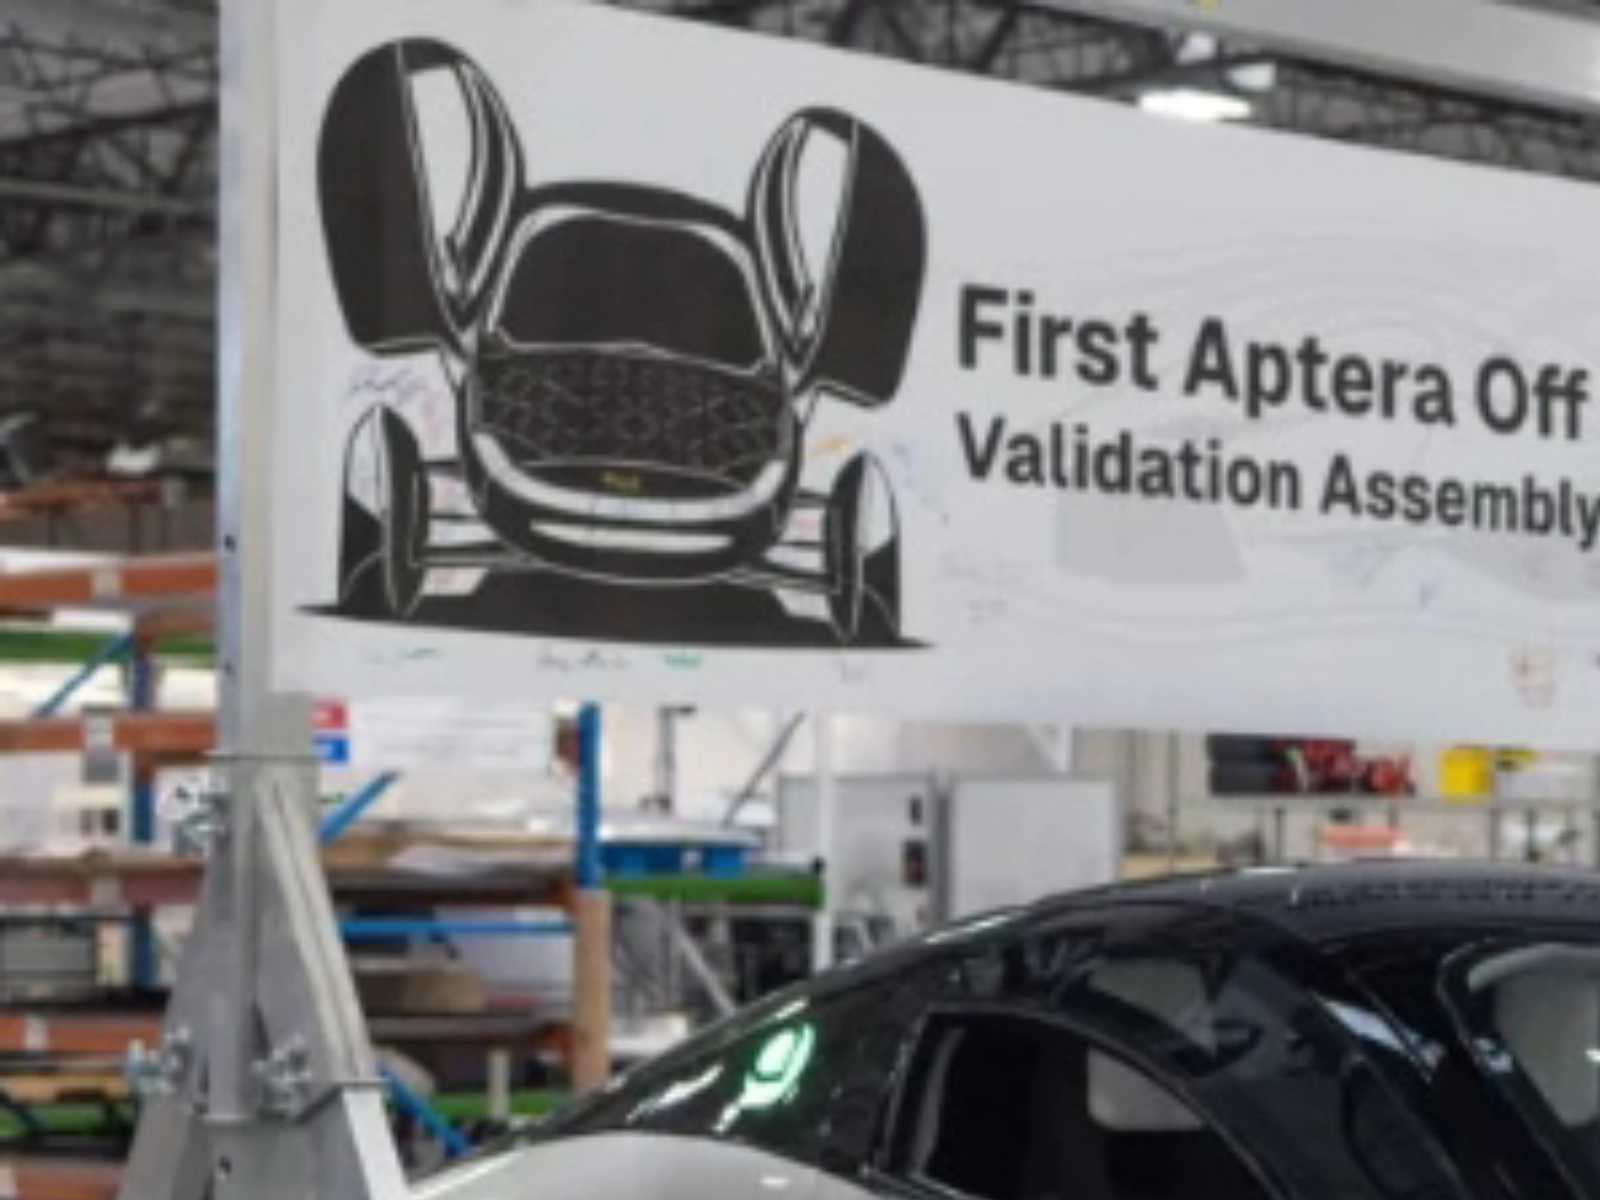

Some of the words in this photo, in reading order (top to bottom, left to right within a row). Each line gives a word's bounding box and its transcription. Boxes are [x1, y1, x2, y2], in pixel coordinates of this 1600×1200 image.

[957, 283, 1158, 391] First
[1183, 318, 1455, 426] Aptera
[1476, 356, 1588, 440] Off
[957, 412, 1300, 510] Validation
